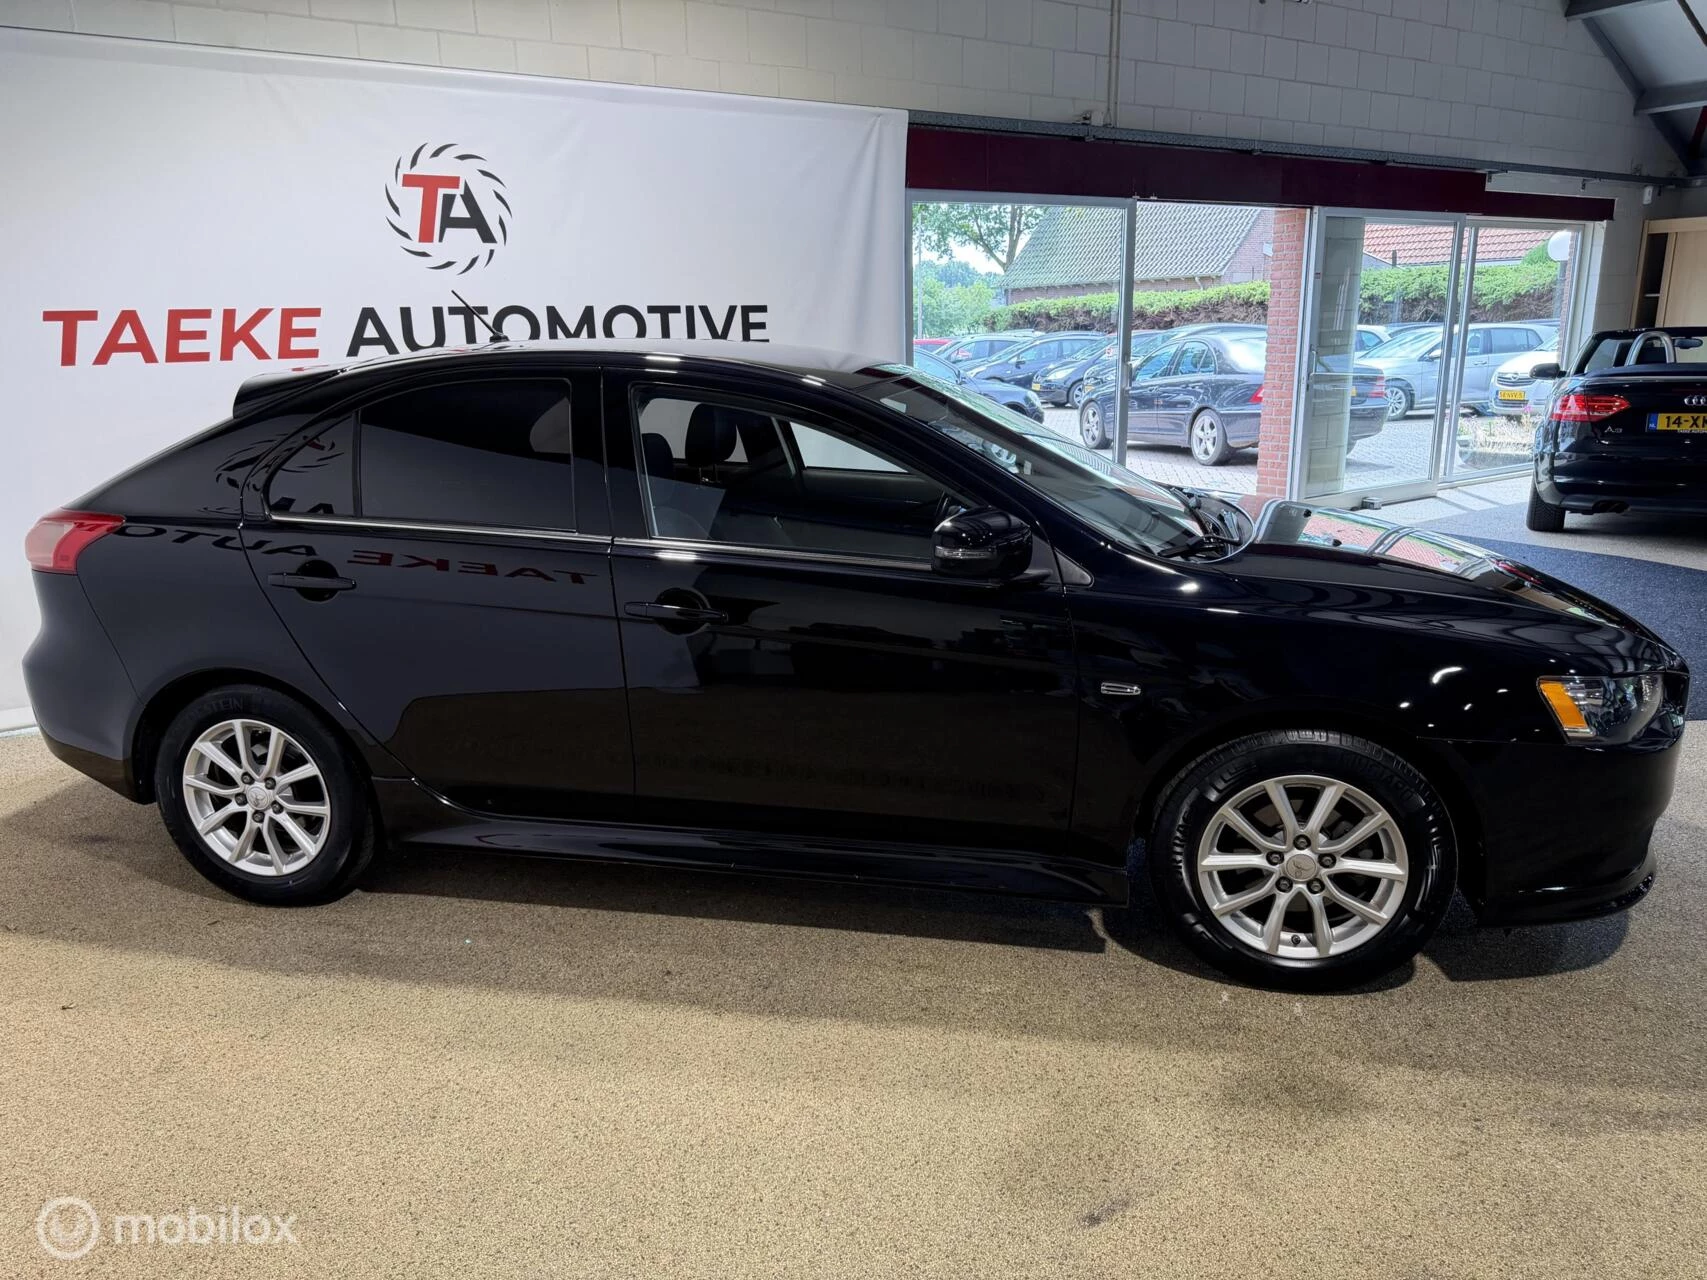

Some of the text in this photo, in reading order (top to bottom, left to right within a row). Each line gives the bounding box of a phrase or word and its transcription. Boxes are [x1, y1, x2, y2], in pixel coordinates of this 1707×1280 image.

[402, 174, 498, 243] TA
[42, 304, 770, 367] TAEKE AUTOMOTIVE
